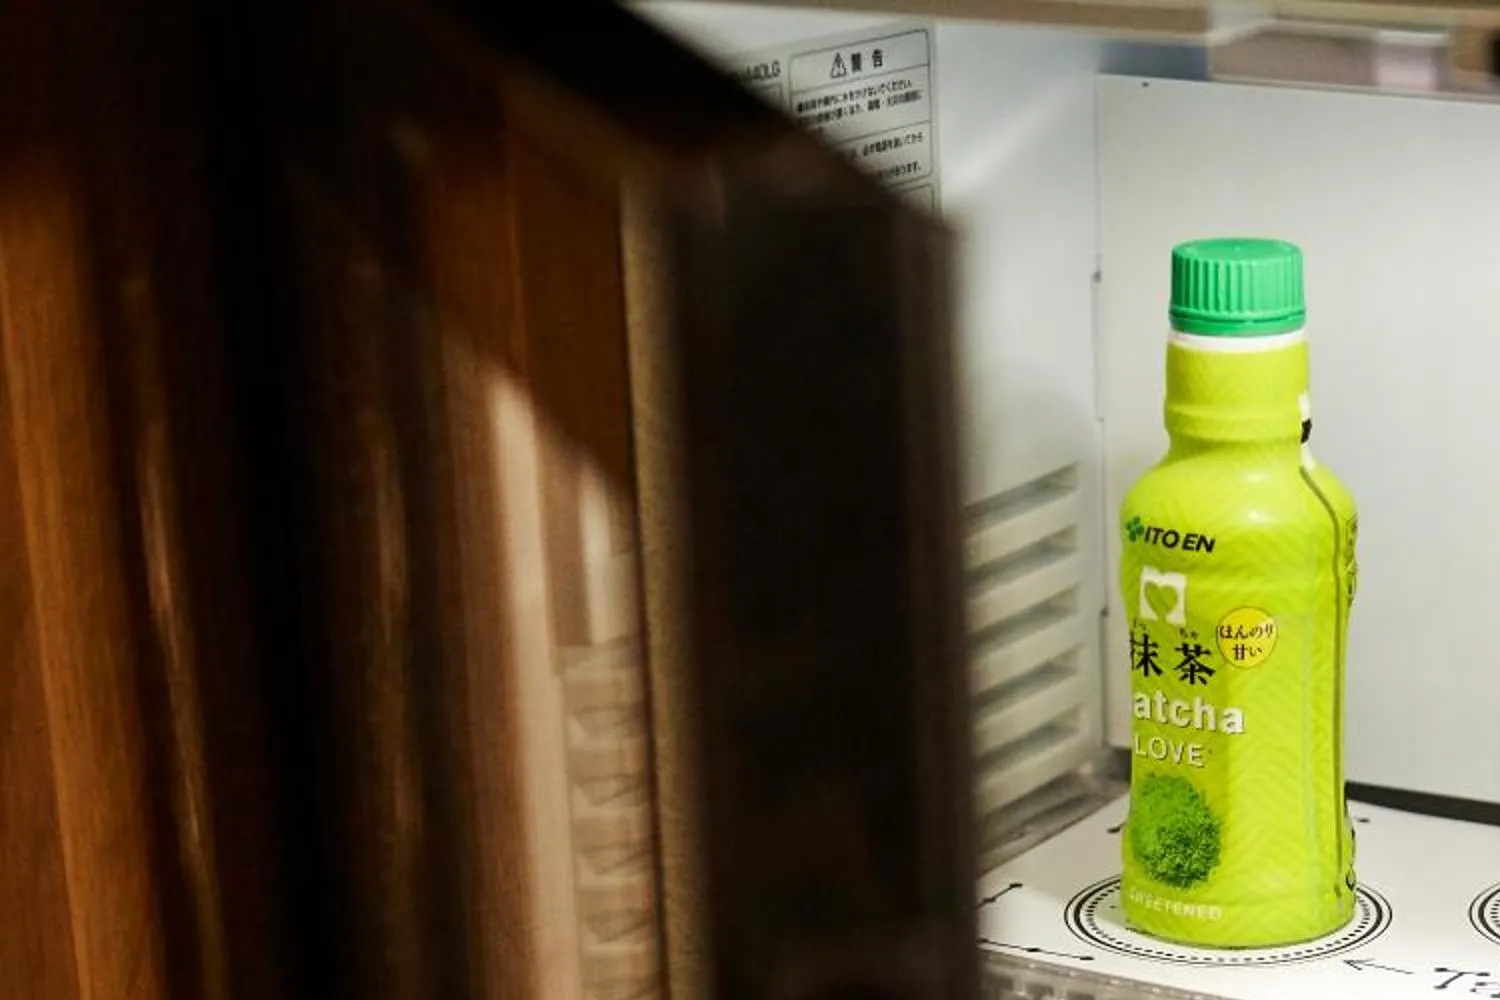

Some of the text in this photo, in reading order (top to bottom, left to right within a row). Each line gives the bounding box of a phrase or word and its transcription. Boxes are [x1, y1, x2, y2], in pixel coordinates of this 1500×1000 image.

[1144, 526, 1216, 553] ITO EN
[1218, 623, 1274, 640] ほんのり
[1232, 643, 1263, 661] 甘い
[1132, 690, 1246, 734] atcha
[1134, 734, 1205, 768] LOVE
